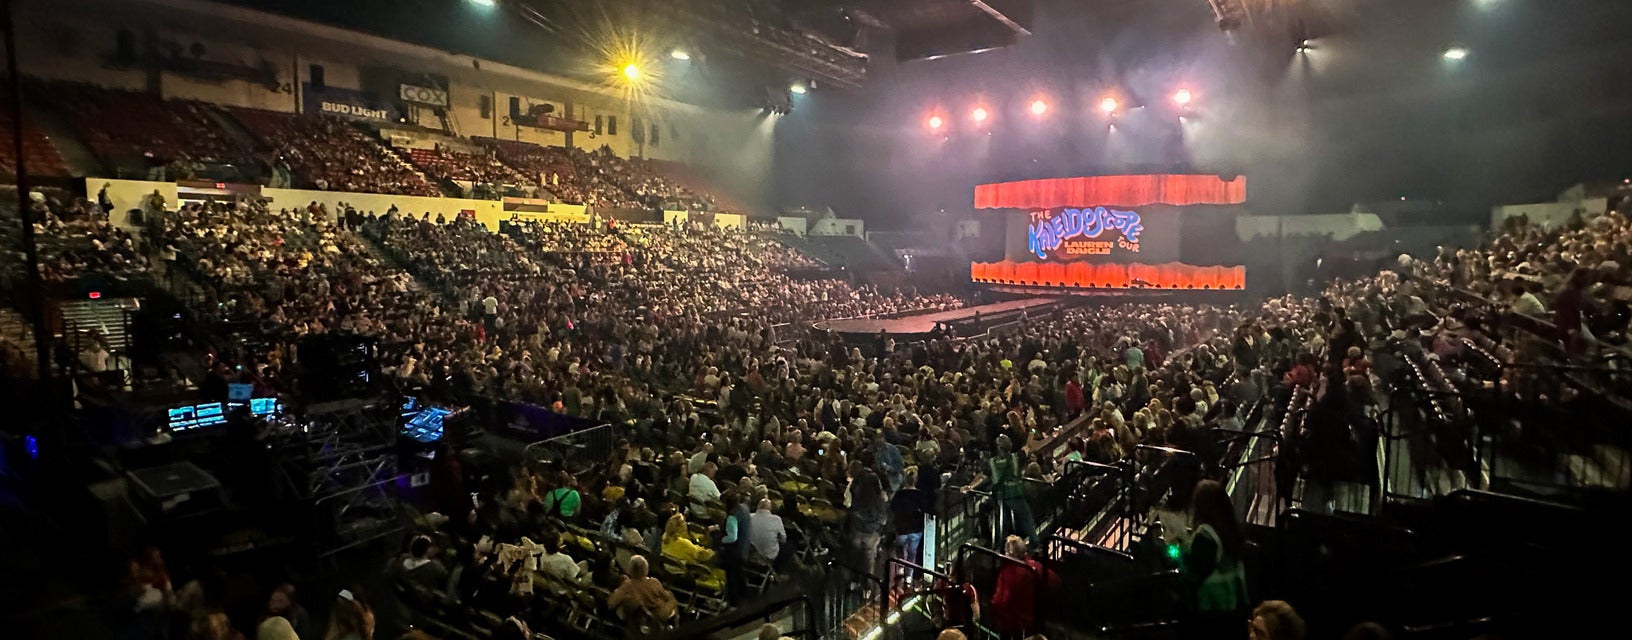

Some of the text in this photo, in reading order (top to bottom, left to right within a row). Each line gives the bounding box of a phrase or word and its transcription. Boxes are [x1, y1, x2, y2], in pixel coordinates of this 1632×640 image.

[271, 82, 292, 95] 24
[403, 87, 445, 102] COX
[322, 102, 388, 119] BUD LIGHT
[502, 116, 509, 126] 2
[589, 129, 595, 139] 3
[1030, 210, 1051, 222] THE
[1029, 207, 1144, 259] KALEIDOSCOPE
[1117, 235, 1139, 252] TOUR
